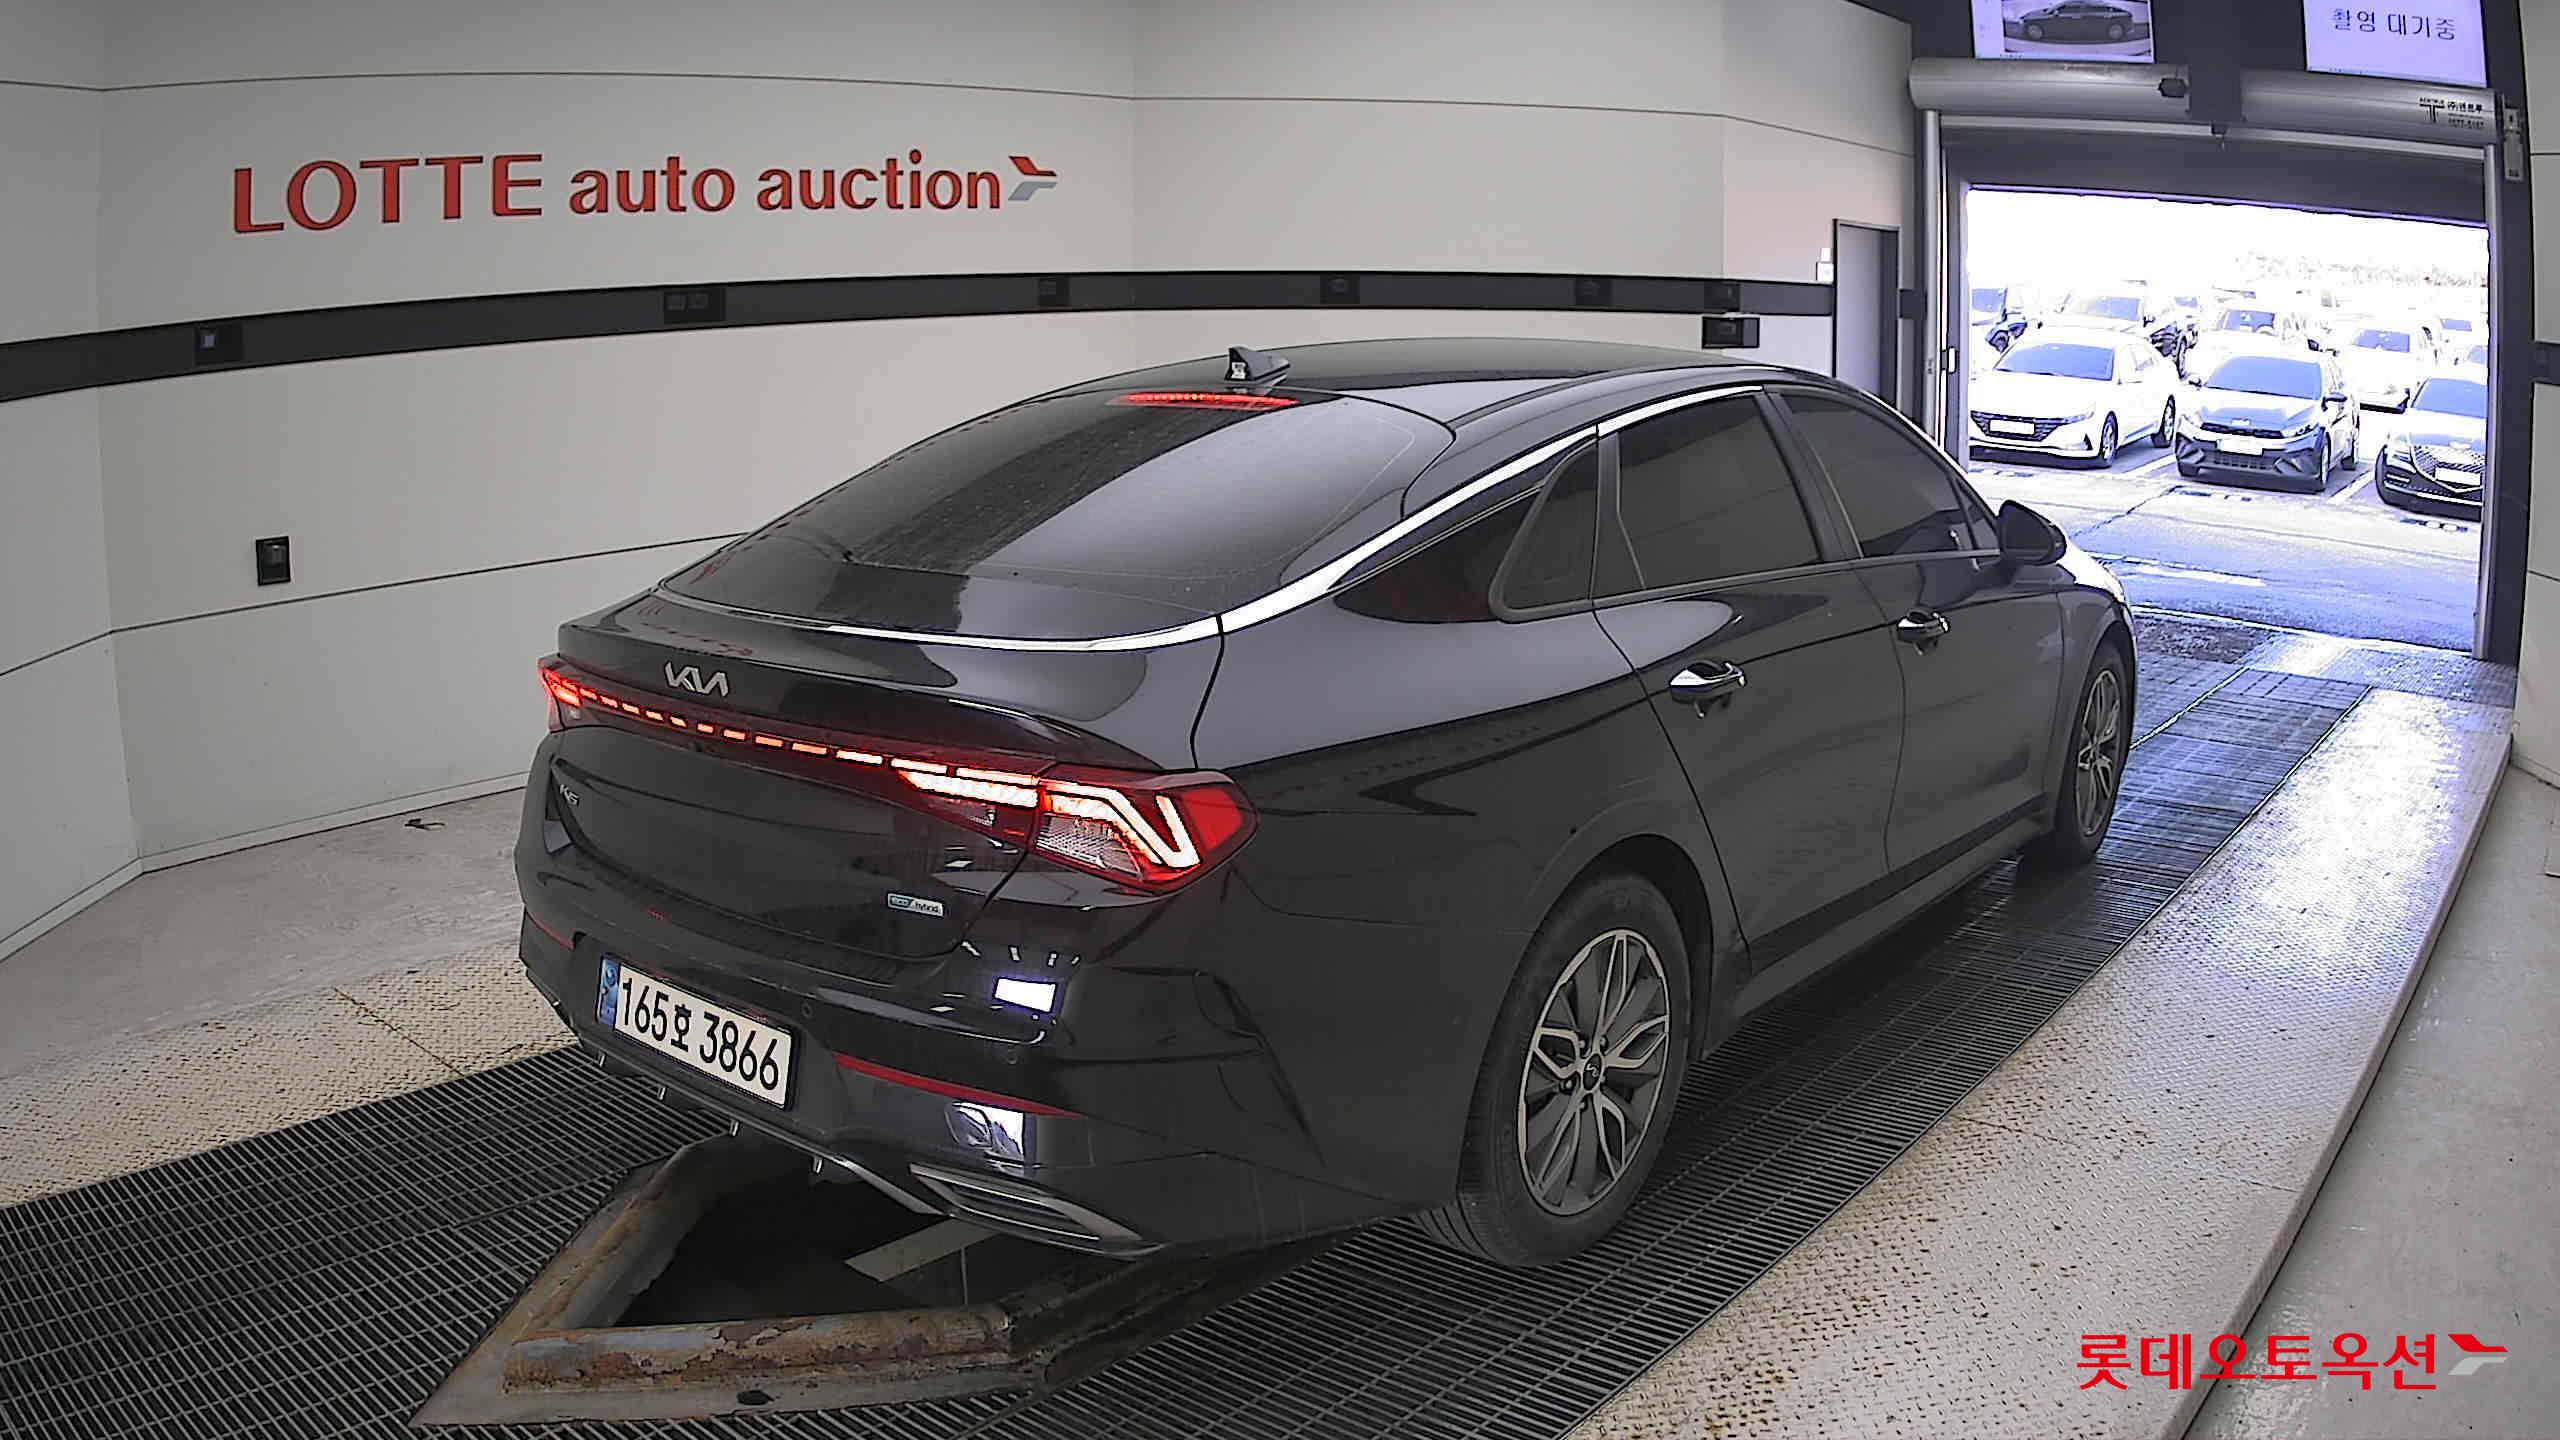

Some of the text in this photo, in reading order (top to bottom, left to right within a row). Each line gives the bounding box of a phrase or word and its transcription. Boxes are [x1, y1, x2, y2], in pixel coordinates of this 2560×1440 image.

[2387, 13, 2456, 41] 대기중
[234, 148, 1001, 234] LOTTE auto auction
[664, 661, 729, 697] KIA
[622, 977, 780, 1091] 165호 3866
